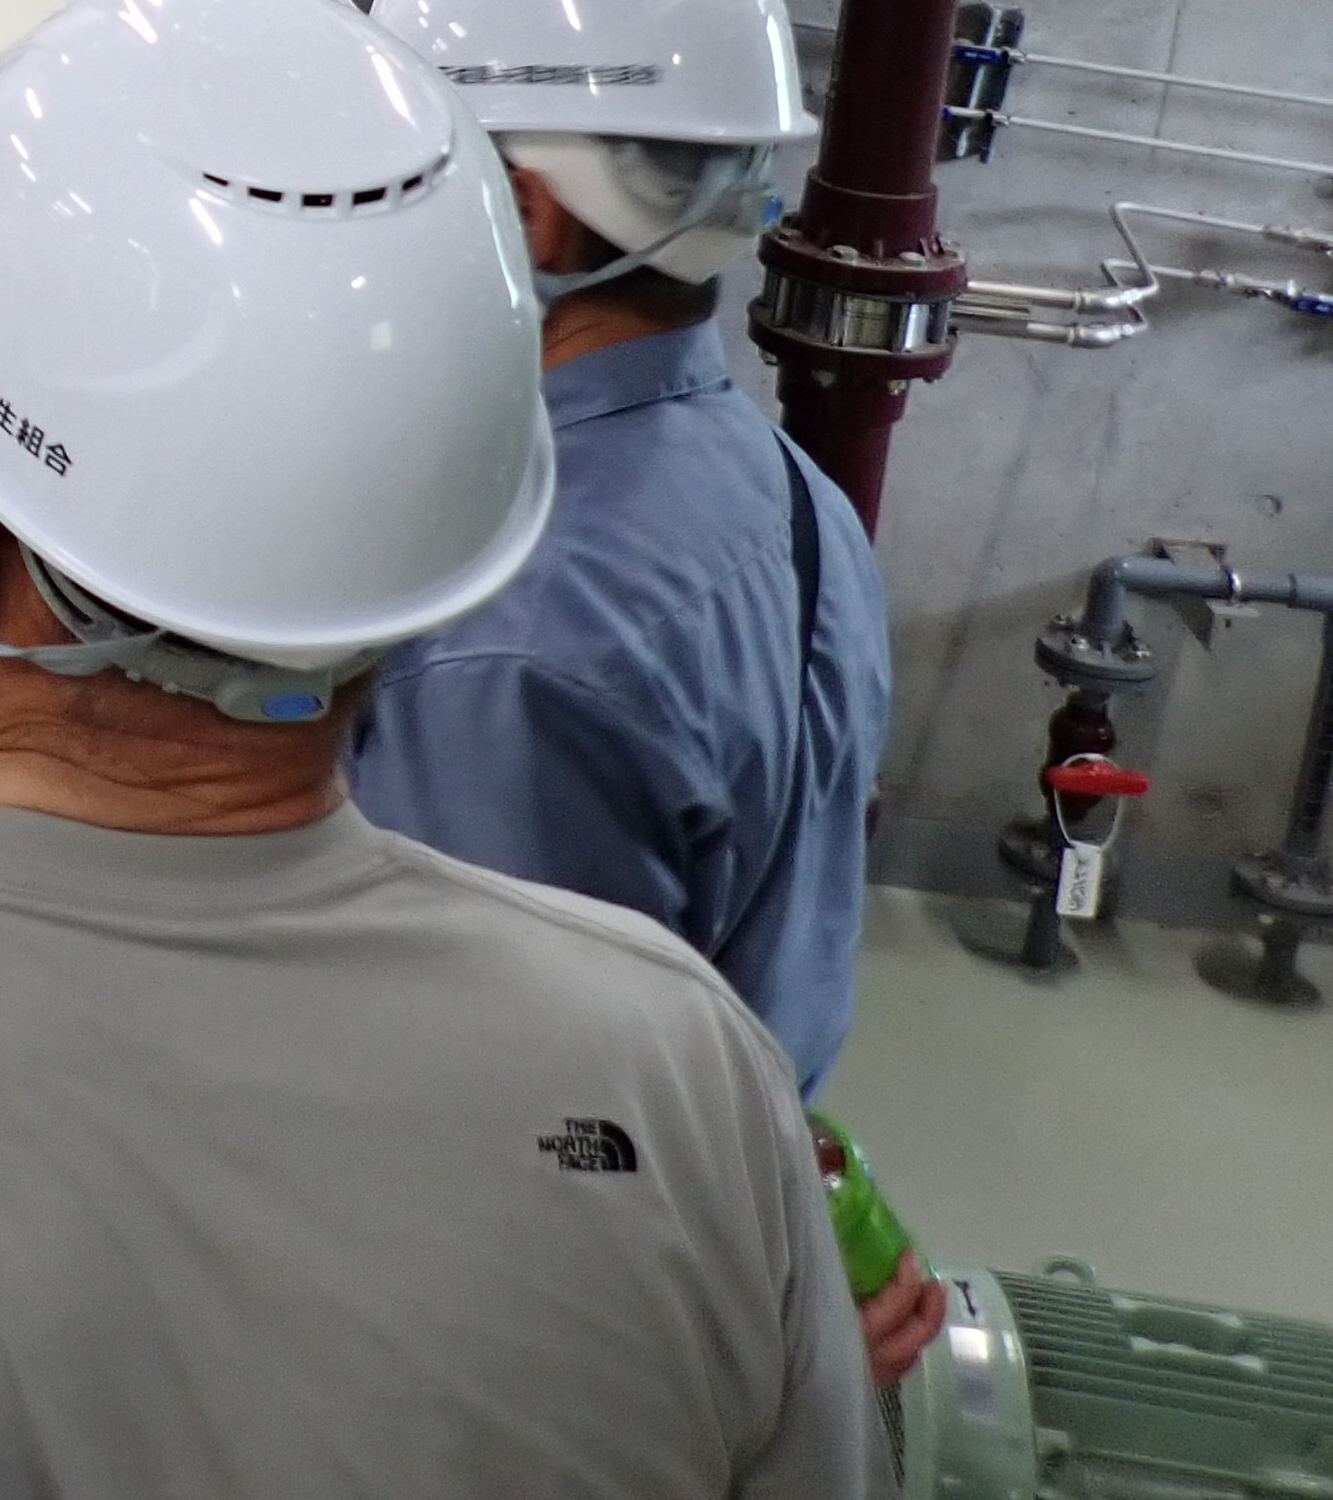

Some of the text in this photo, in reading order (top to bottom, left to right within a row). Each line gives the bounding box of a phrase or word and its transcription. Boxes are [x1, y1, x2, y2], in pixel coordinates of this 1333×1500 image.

[564, 1117, 597, 1135] THE
[537, 1133, 598, 1157] NORTH
[557, 1153, 599, 1172] FACE
